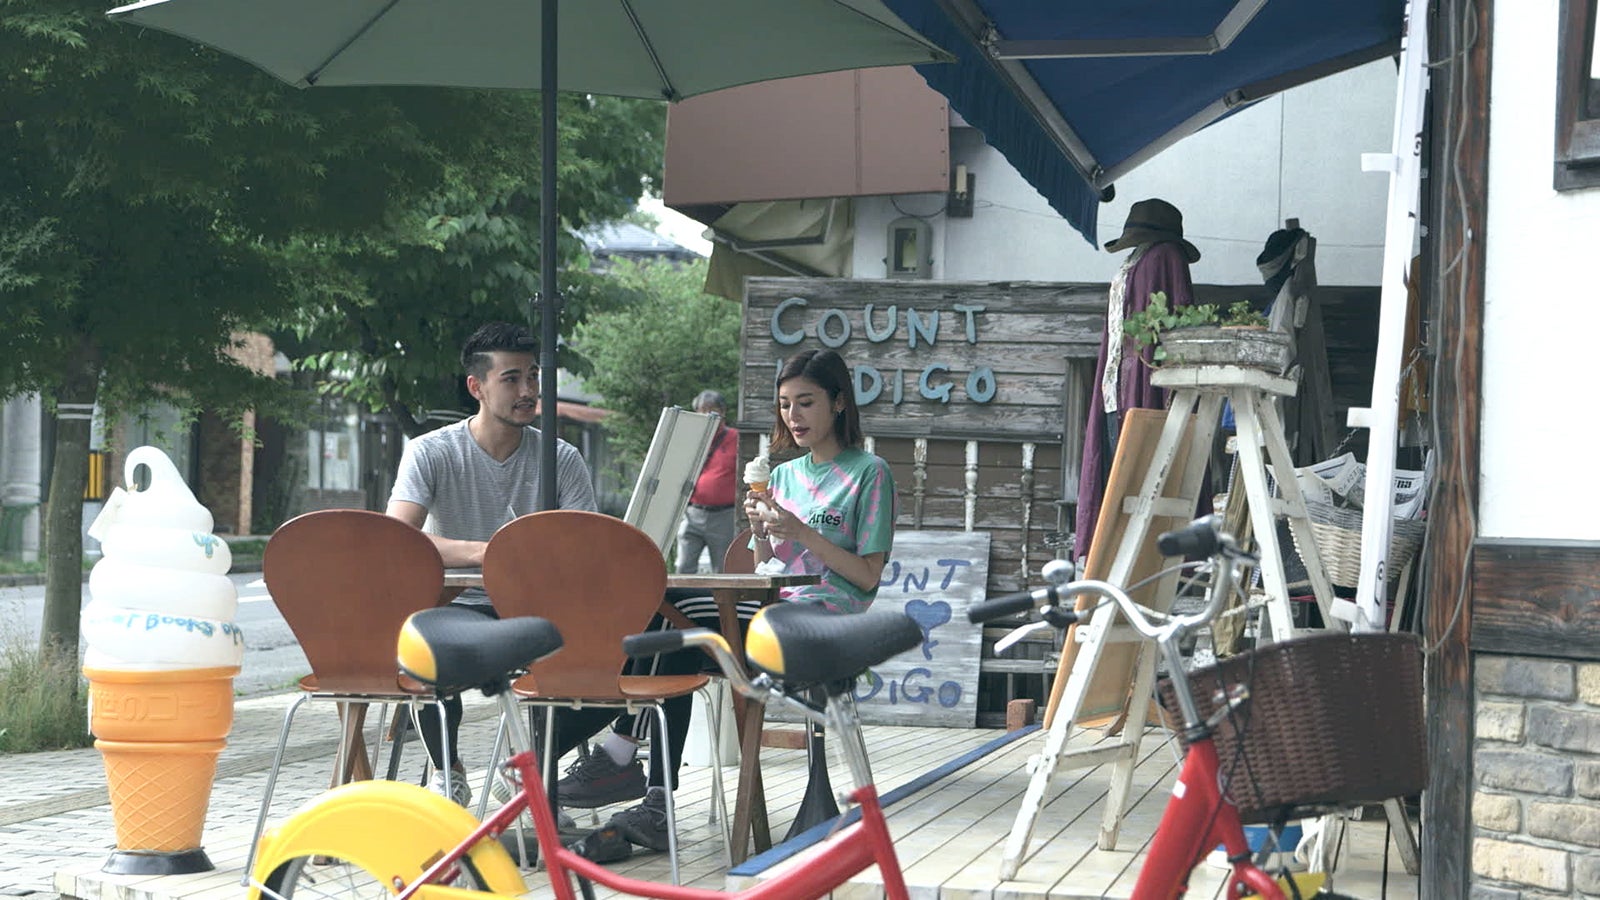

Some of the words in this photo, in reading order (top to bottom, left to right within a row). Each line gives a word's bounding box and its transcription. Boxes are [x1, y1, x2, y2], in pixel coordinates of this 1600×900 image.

[771, 297, 986, 348] COUNT
[773, 358, 997, 406] IDIGO
[808, 510, 842, 526] Aries
[852, 667, 962, 709] DIGO
